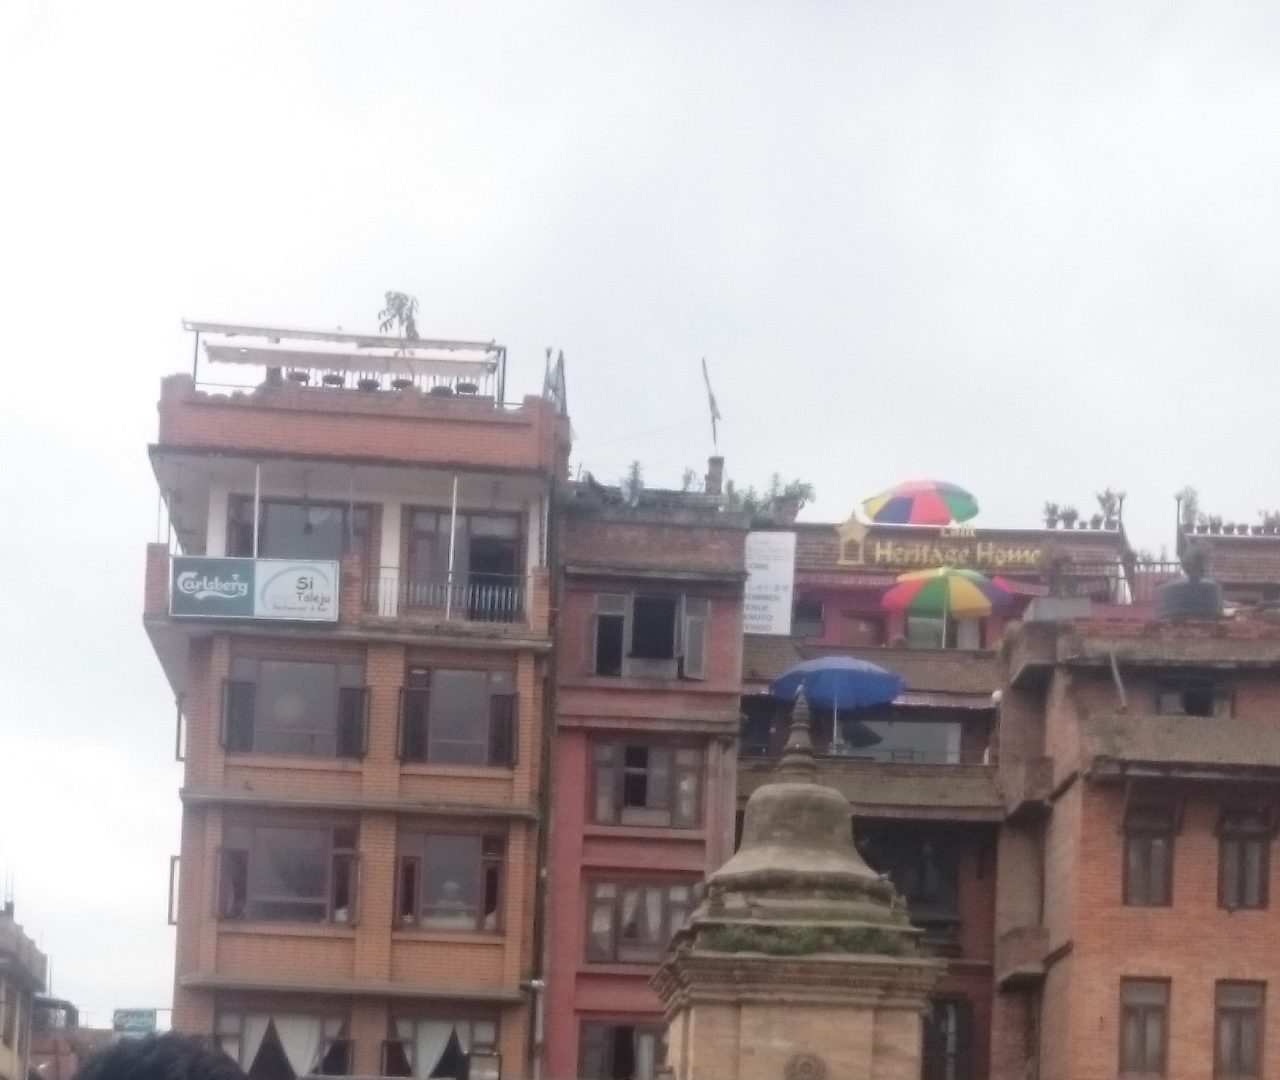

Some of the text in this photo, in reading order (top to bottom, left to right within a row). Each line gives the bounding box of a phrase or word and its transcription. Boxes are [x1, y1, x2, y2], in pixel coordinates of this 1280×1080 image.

[875, 541, 1042, 567] Heritage Home
[177, 571, 248, 597] Carlsberg
[296, 576, 314, 590] Si
